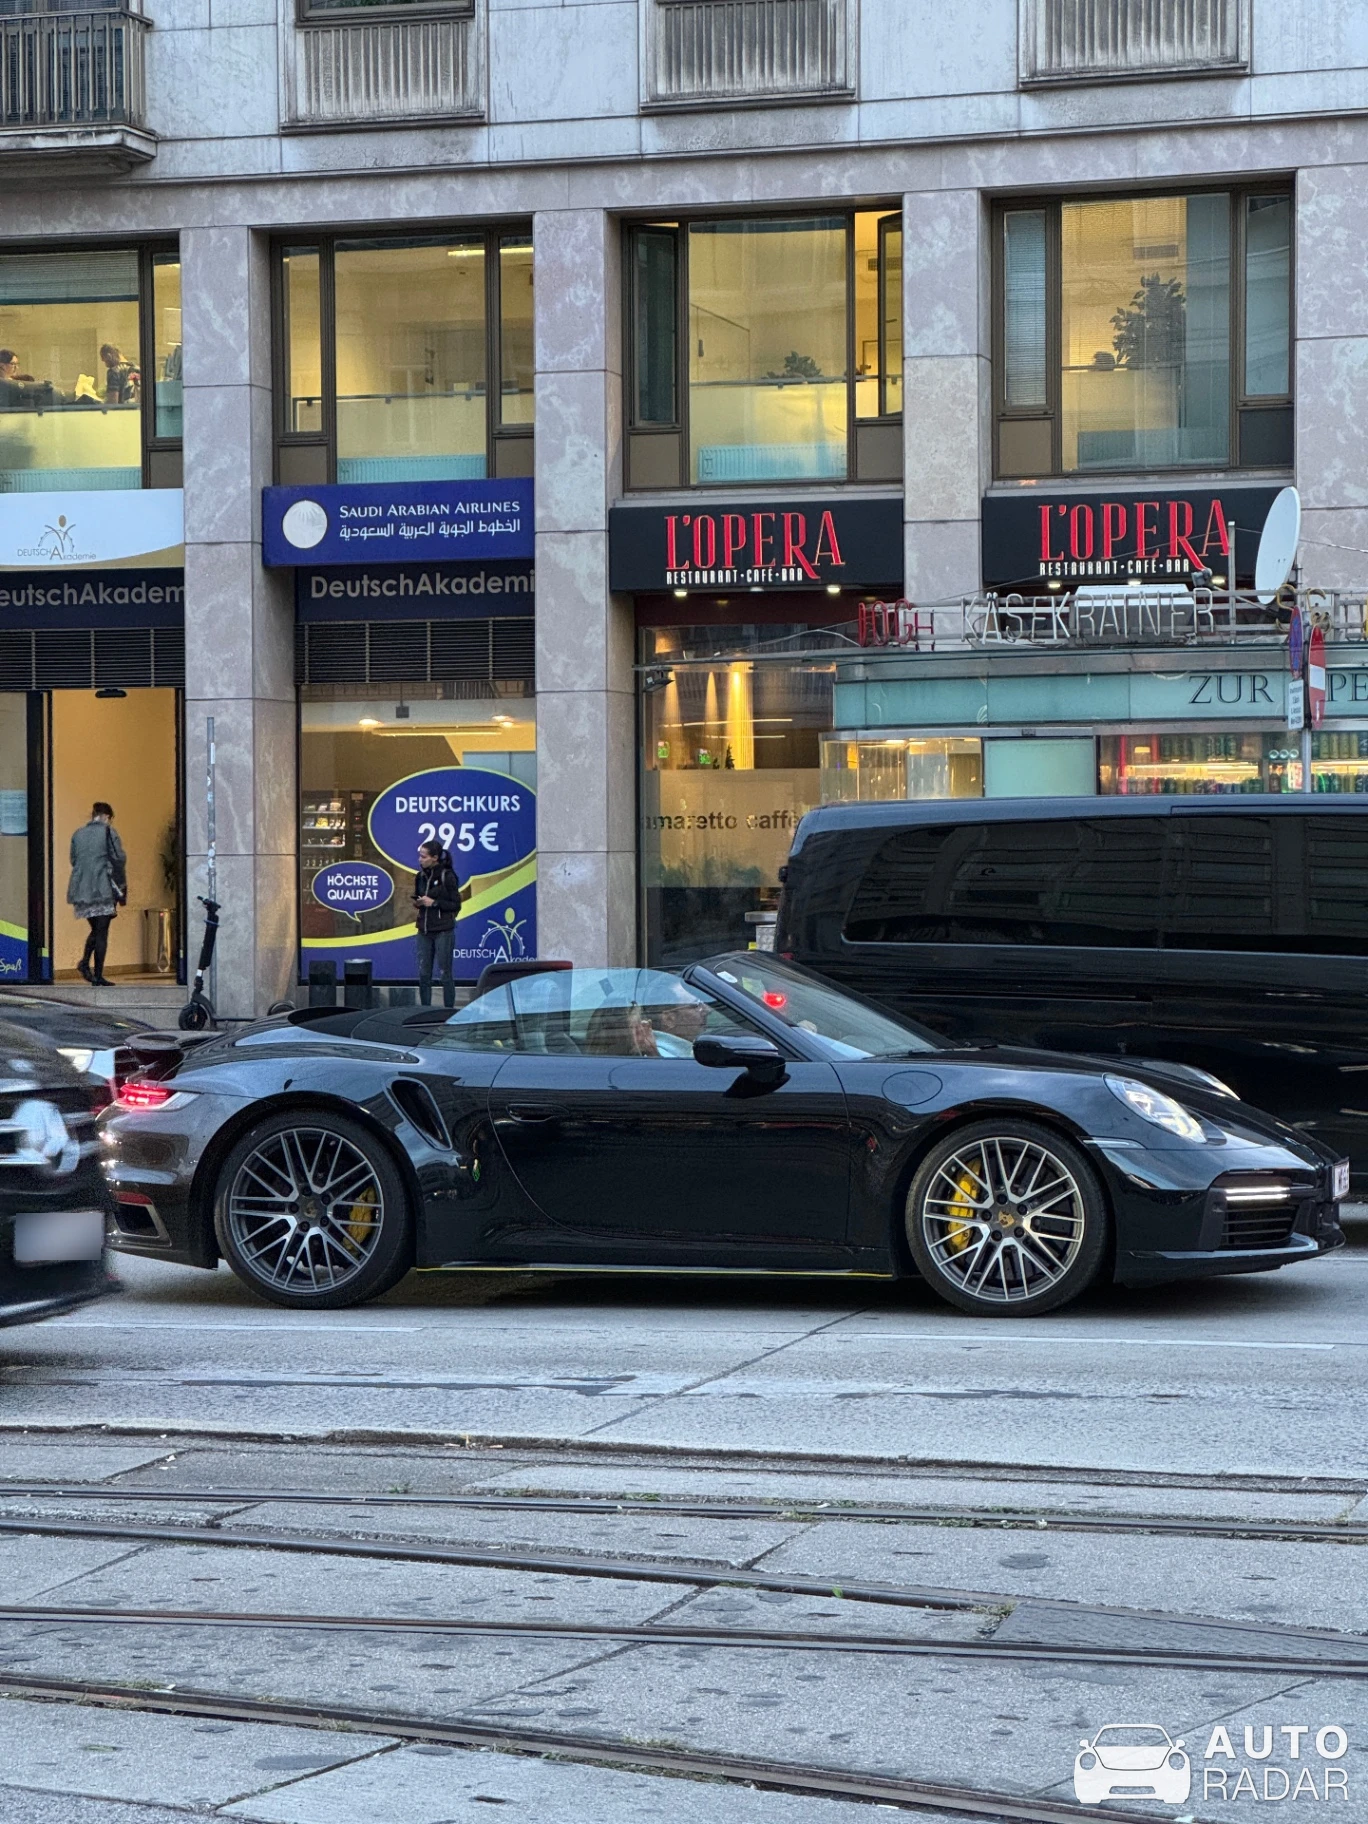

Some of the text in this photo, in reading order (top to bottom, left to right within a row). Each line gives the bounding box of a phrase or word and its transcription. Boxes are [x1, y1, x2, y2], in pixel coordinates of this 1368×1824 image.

[339, 501, 521, 518] SAUDI ARABIAN AIRLINES
[339, 518, 521, 541] الخطوط الجوية العربية السعودية
[0, 581, 184, 607] eutschAkadem
[311, 569, 535, 598] DeutschAkademi
[1188, 673, 1368, 704] ZUR PE
[395, 795, 521, 813] DEUTSCHKURS
[417, 822, 499, 852] 295€
[327, 873, 379, 886] HÖCHSTE
[327, 888, 379, 901] QUALITÄT
